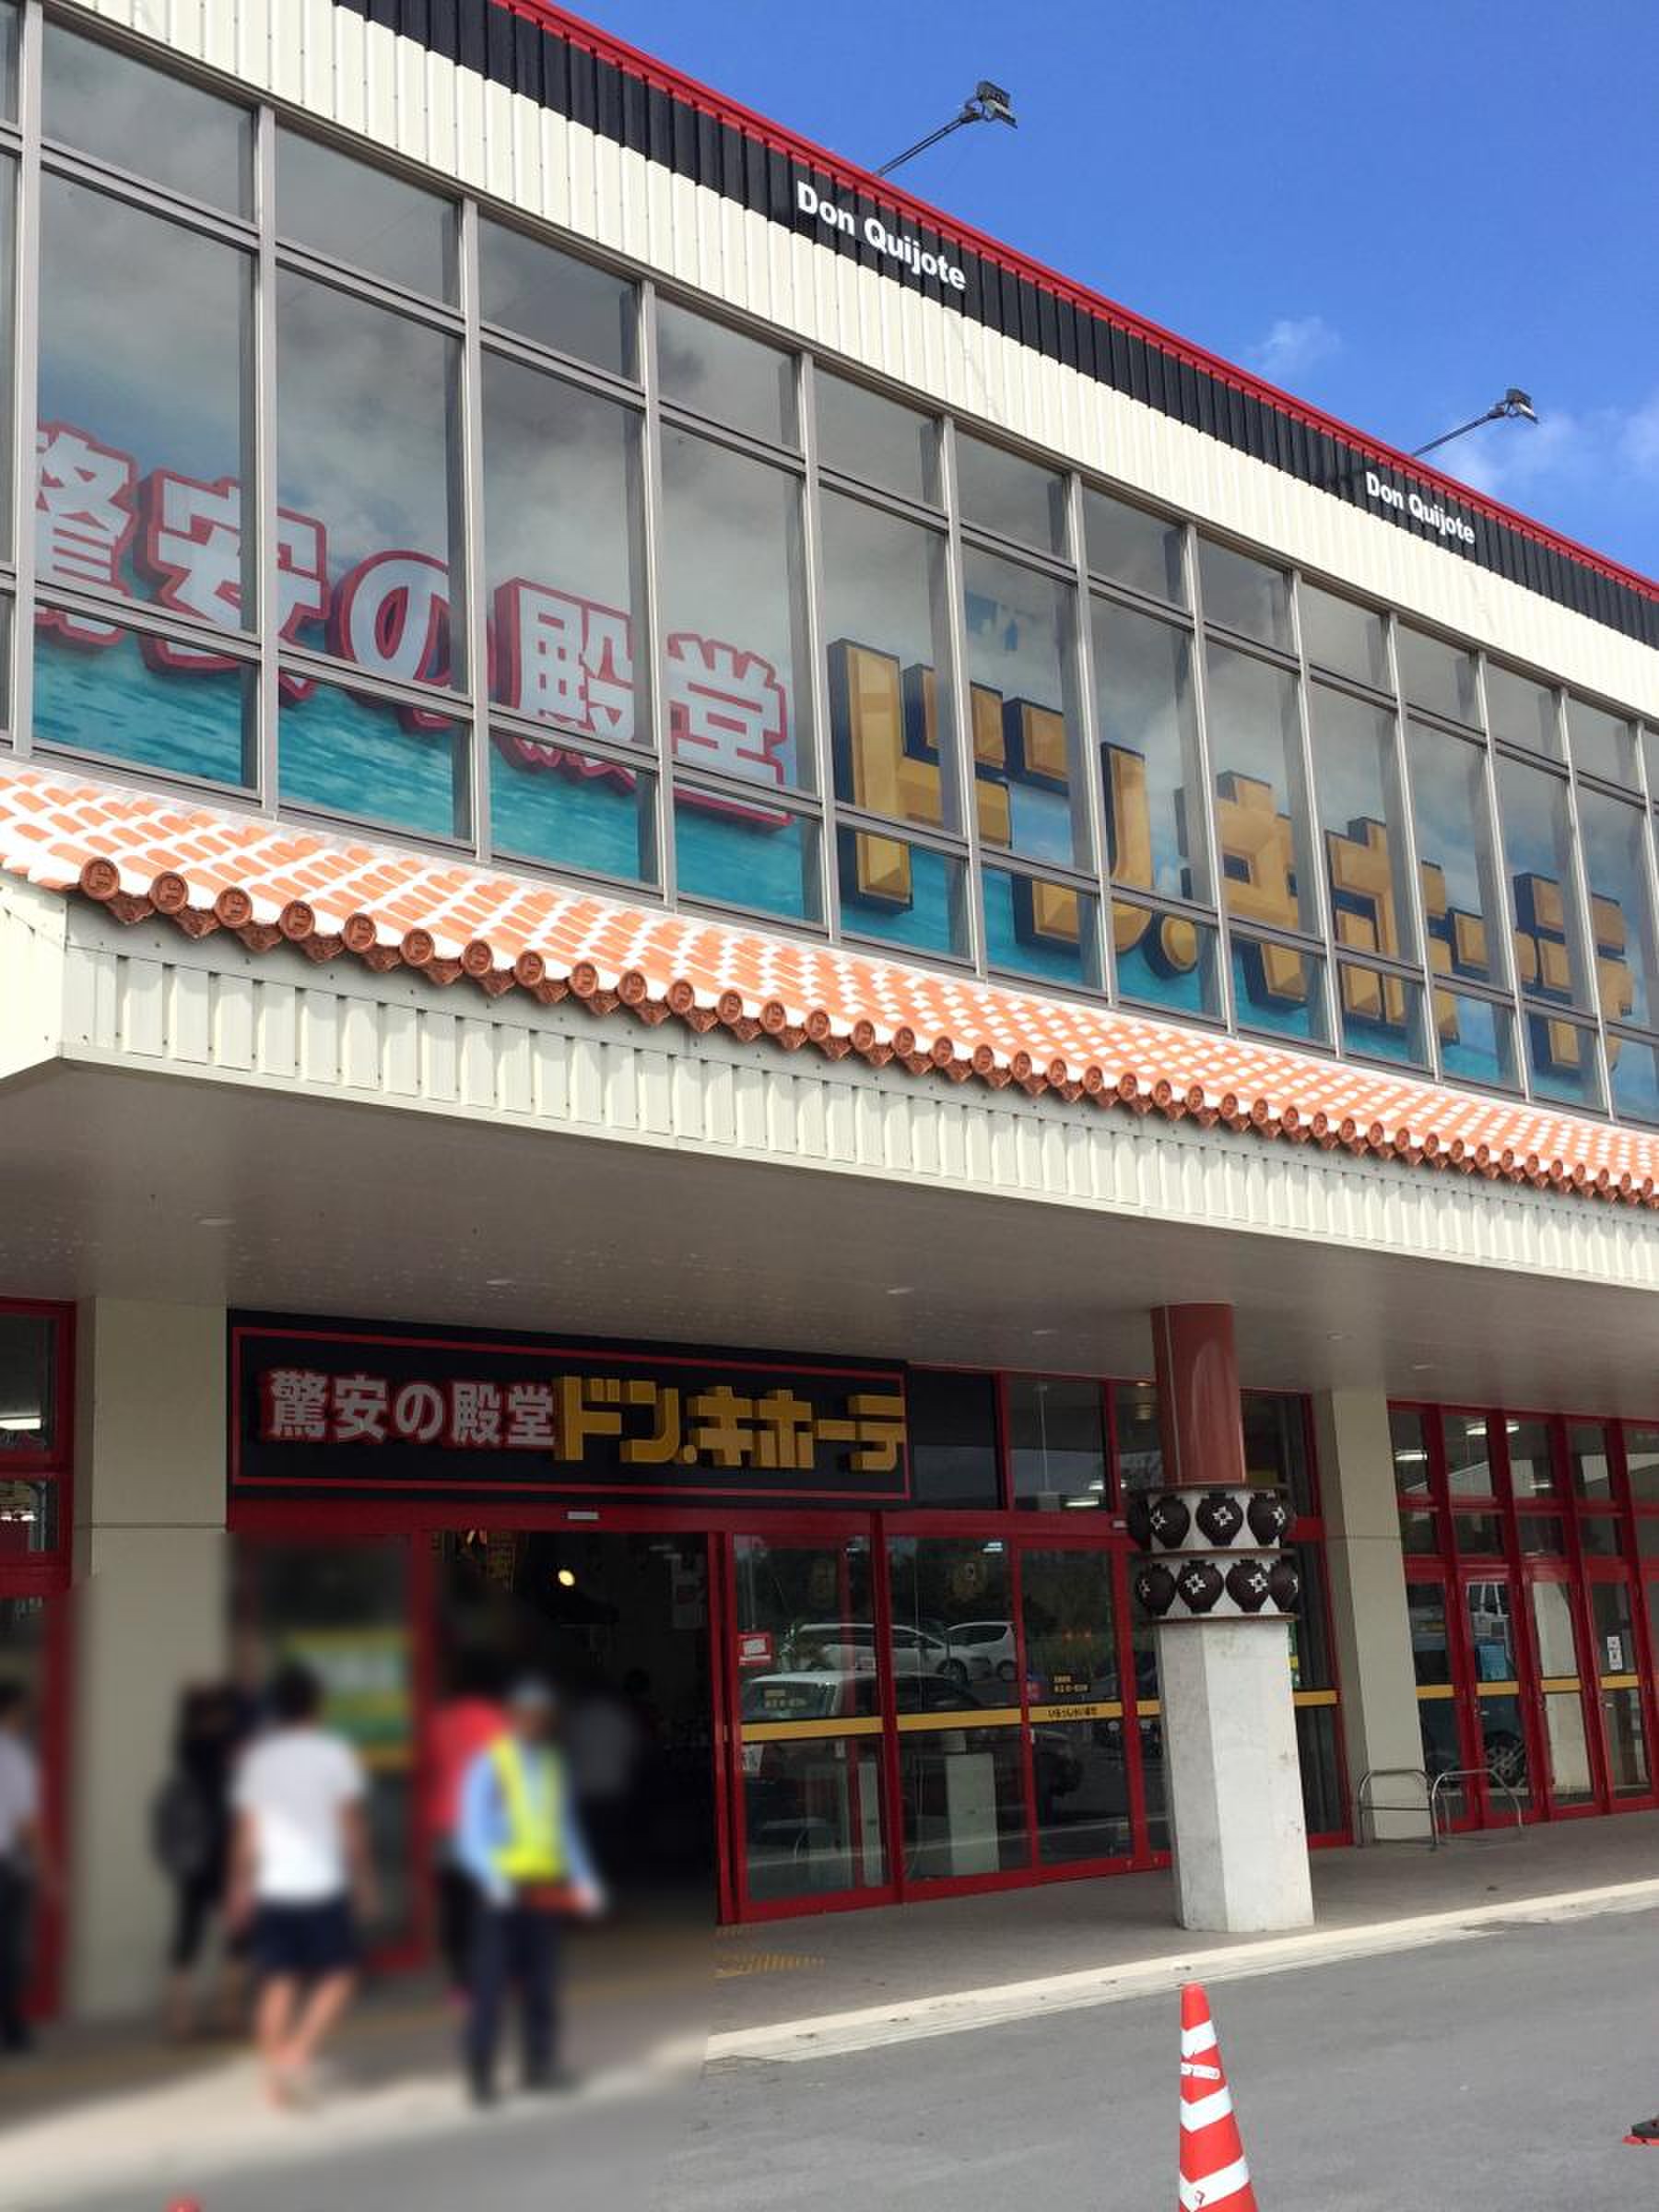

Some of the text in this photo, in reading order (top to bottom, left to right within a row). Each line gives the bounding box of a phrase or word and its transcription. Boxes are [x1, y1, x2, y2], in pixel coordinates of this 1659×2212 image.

[796, 180, 967, 291] Don Quijote
[1365, 471, 1475, 545] Don Quijote
[267, 1368, 555, 1449] 驚安の殿堂
